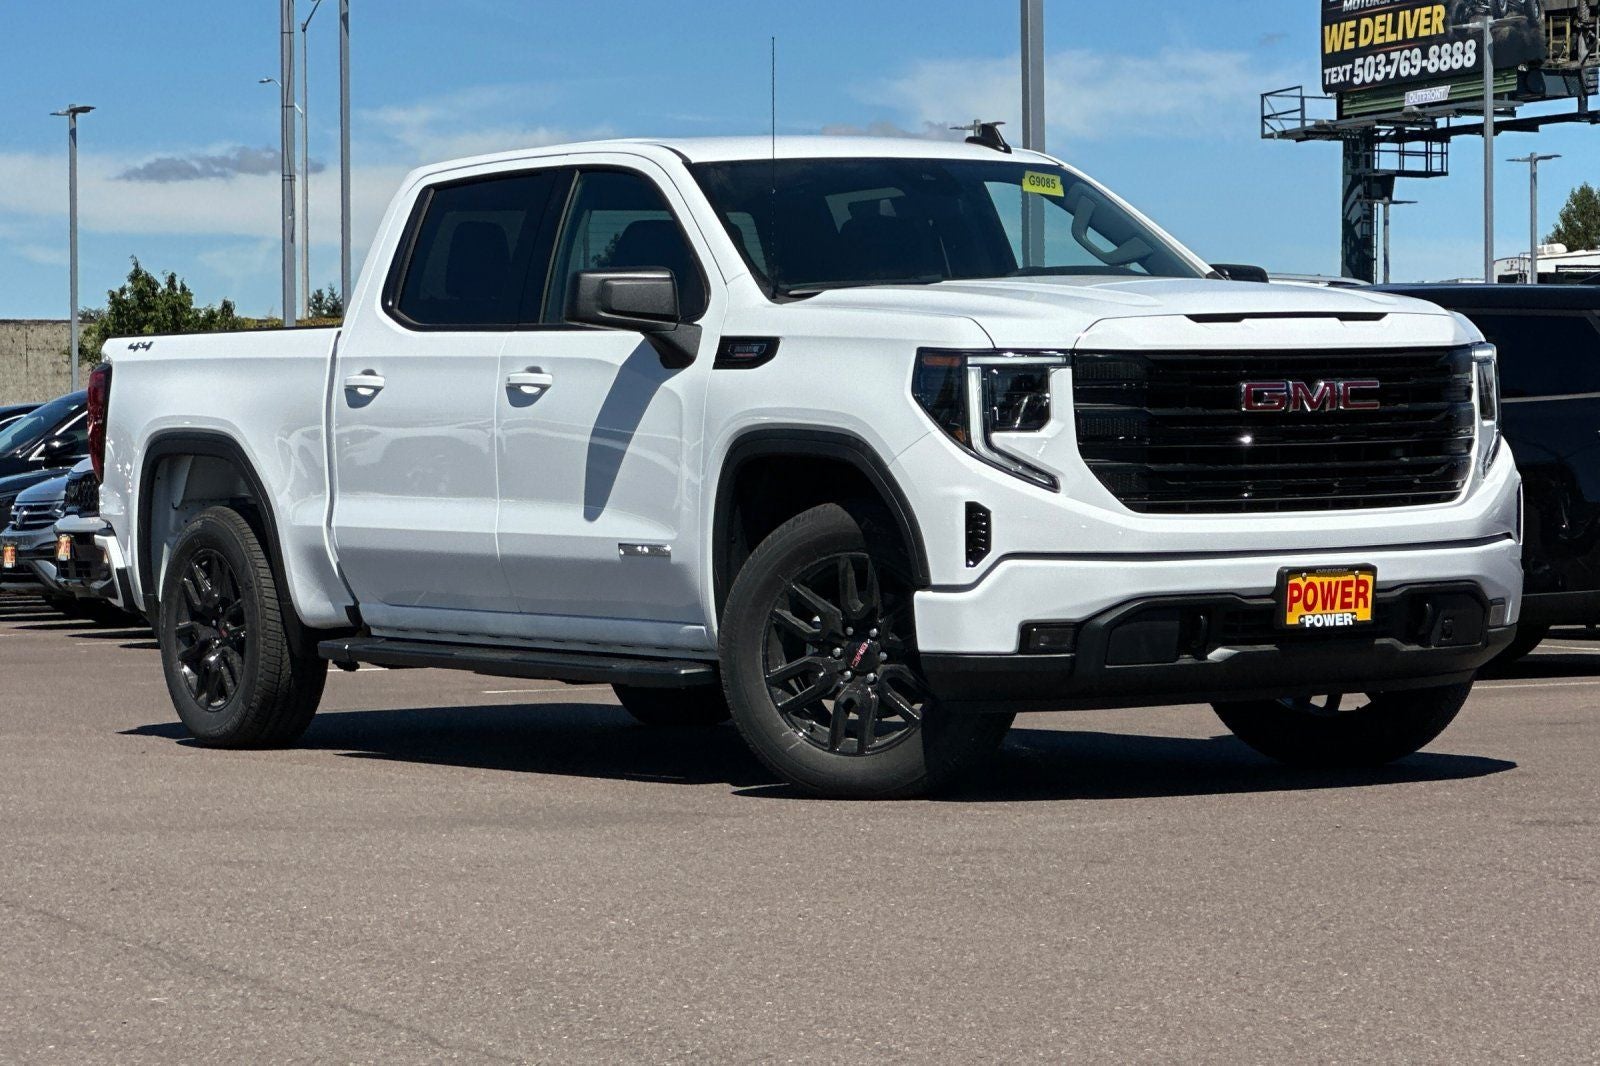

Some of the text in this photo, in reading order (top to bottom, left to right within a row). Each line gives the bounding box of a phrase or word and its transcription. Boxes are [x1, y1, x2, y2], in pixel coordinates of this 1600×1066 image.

[1324, 4, 1446, 54] WE DELIVER
[1324, 39, 1477, 86] TEXT 503-769-8888
[1408, 88, 1446, 103] OUTFRONT
[1028, 174, 1056, 189] G9085
[1240, 379, 1380, 412] GMC
[1287, 579, 1370, 613] POWER
[1304, 612, 1354, 628] POWER
